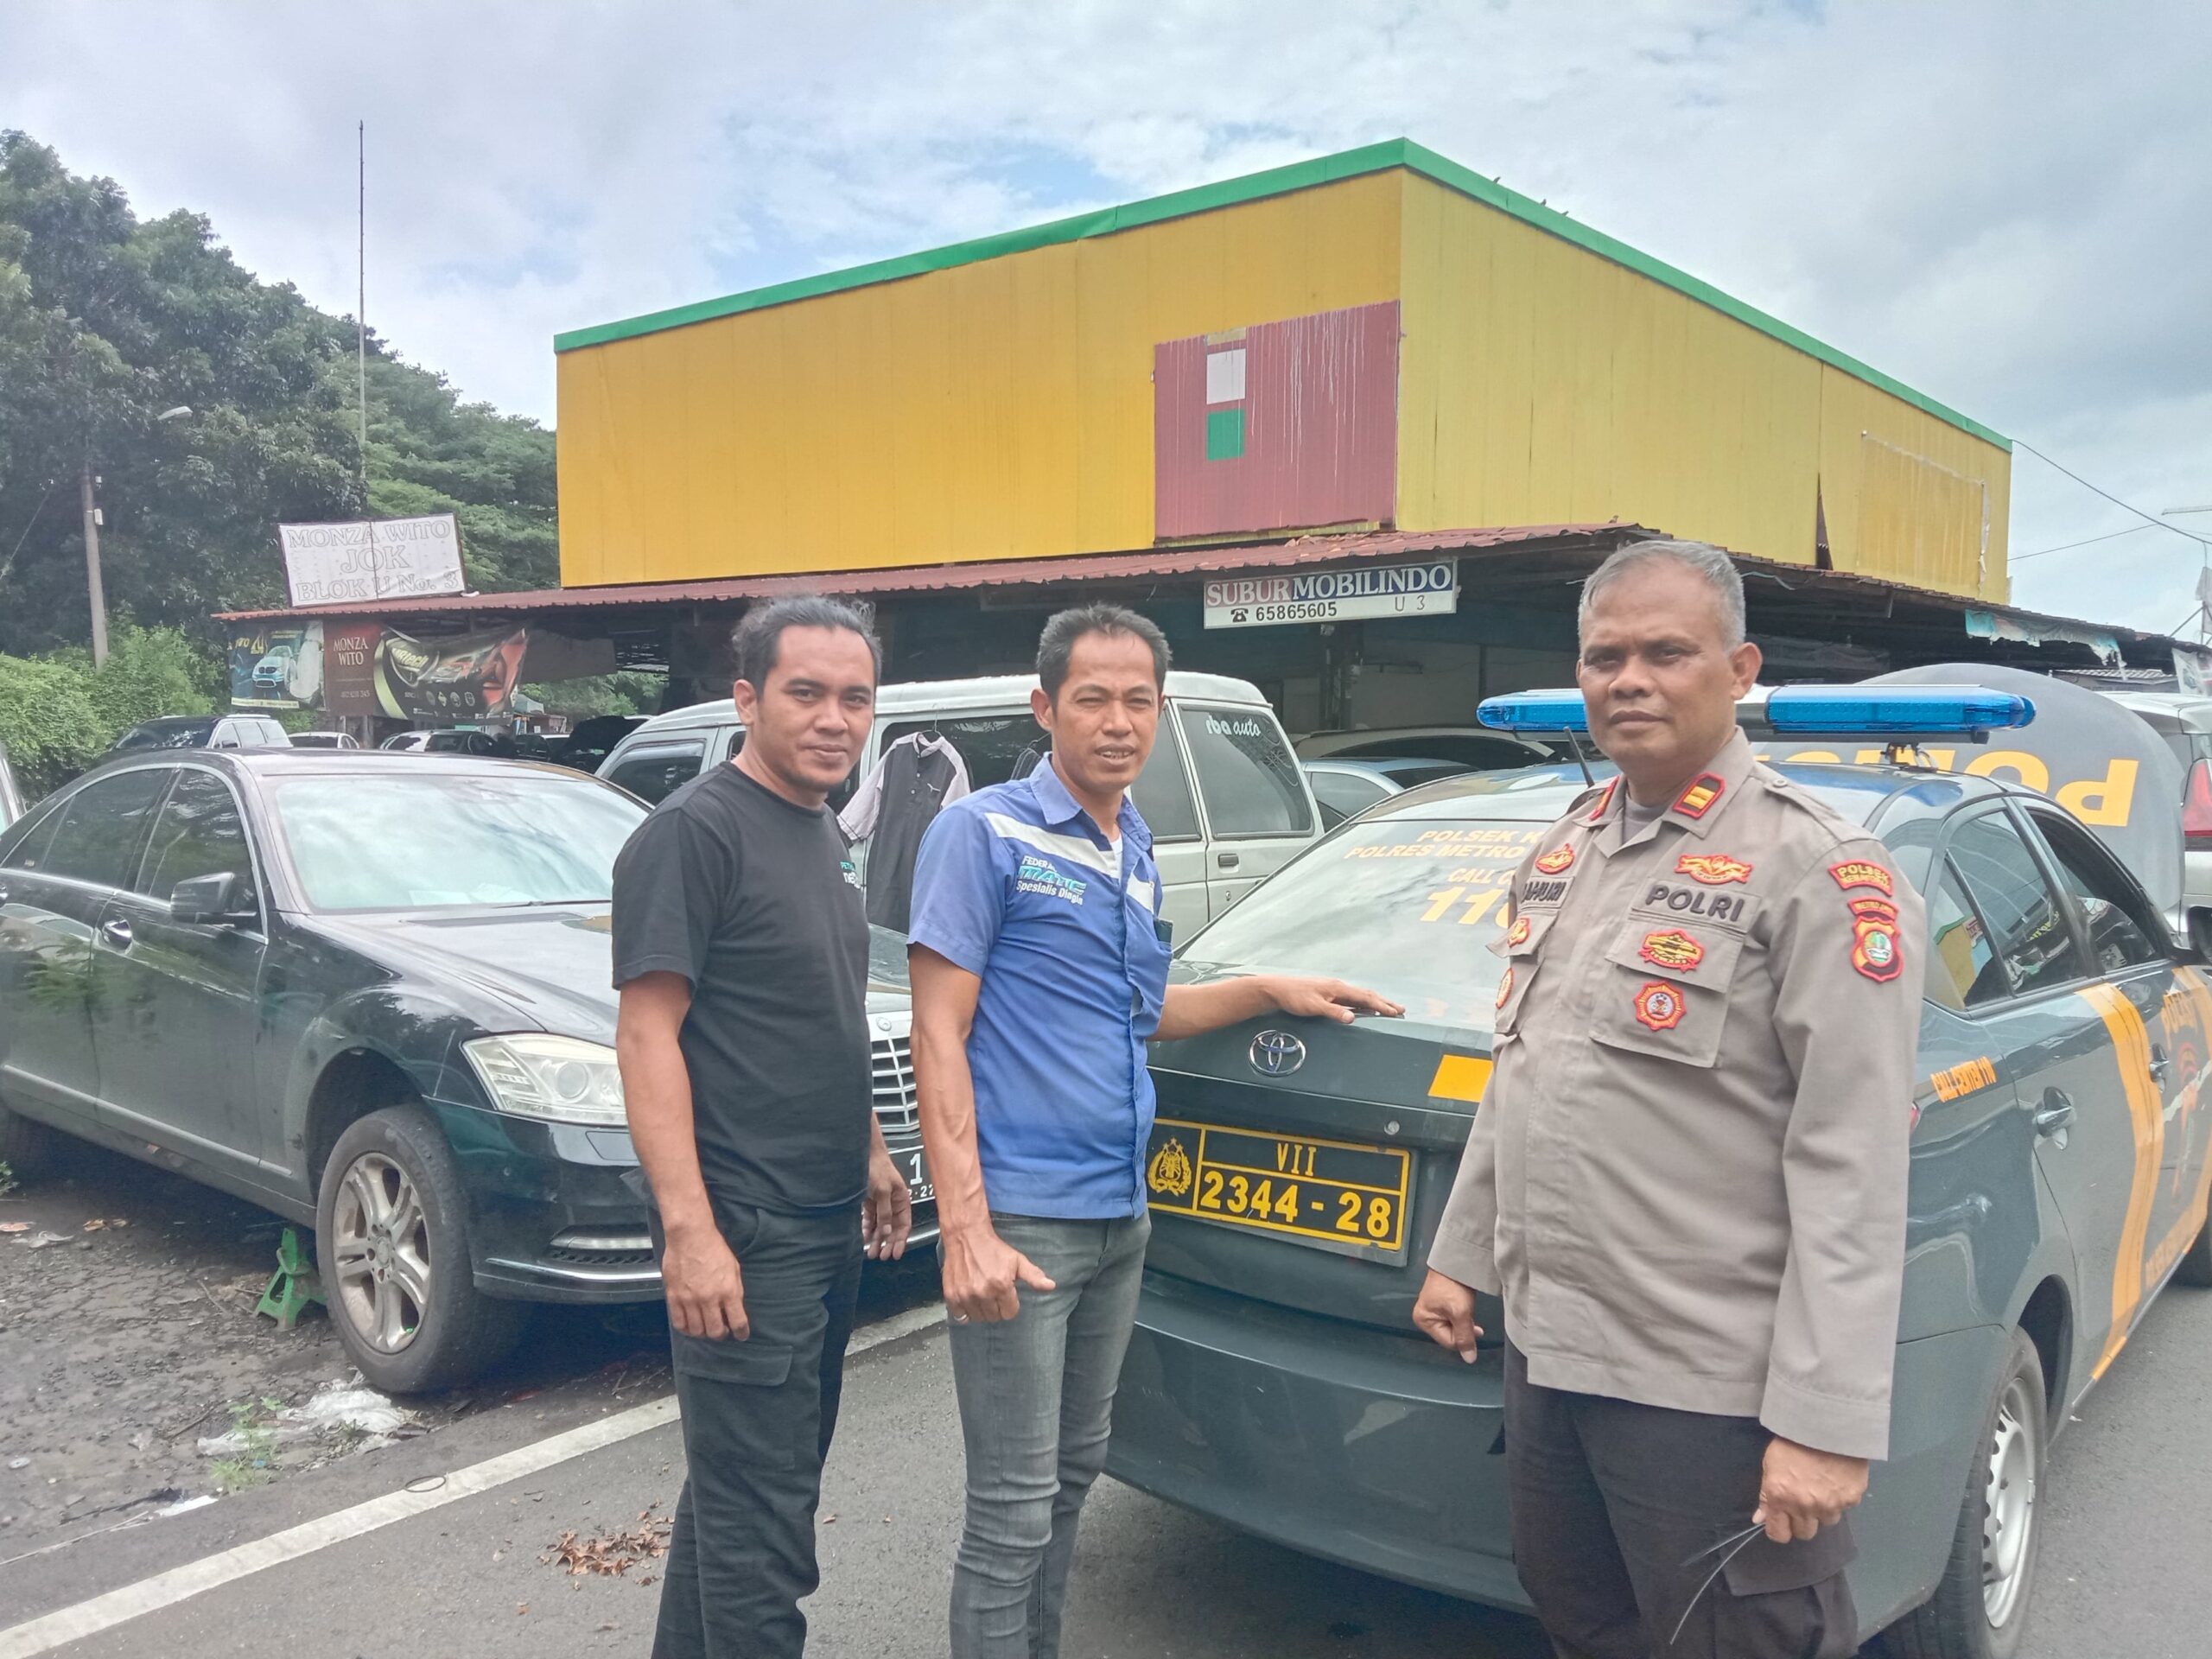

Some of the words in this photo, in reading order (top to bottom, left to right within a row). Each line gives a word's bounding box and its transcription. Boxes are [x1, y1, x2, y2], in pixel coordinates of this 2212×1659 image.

[288, 523, 380, 548] MONZA
[385, 520, 450, 543] WITO
[341, 545, 410, 573] JOK
[296, 579, 367, 601] BLOK
[443, 571, 459, 589] 3
[1255, 601, 1337, 622] 65865605
[1395, 595, 1405, 612] U
[1417, 594, 1425, 611] 3
[333, 637, 370, 652] MONZA
[338, 652, 364, 665] WITO
[1418, 830, 1516, 842] POLSEK
[1345, 845, 1433, 858] POLRES
[1437, 845, 1526, 858] METRO
[1447, 868, 1495, 884] CALL
[1645, 884, 1745, 922] POLRI
[1276, 1142, 1318, 1177] VII
